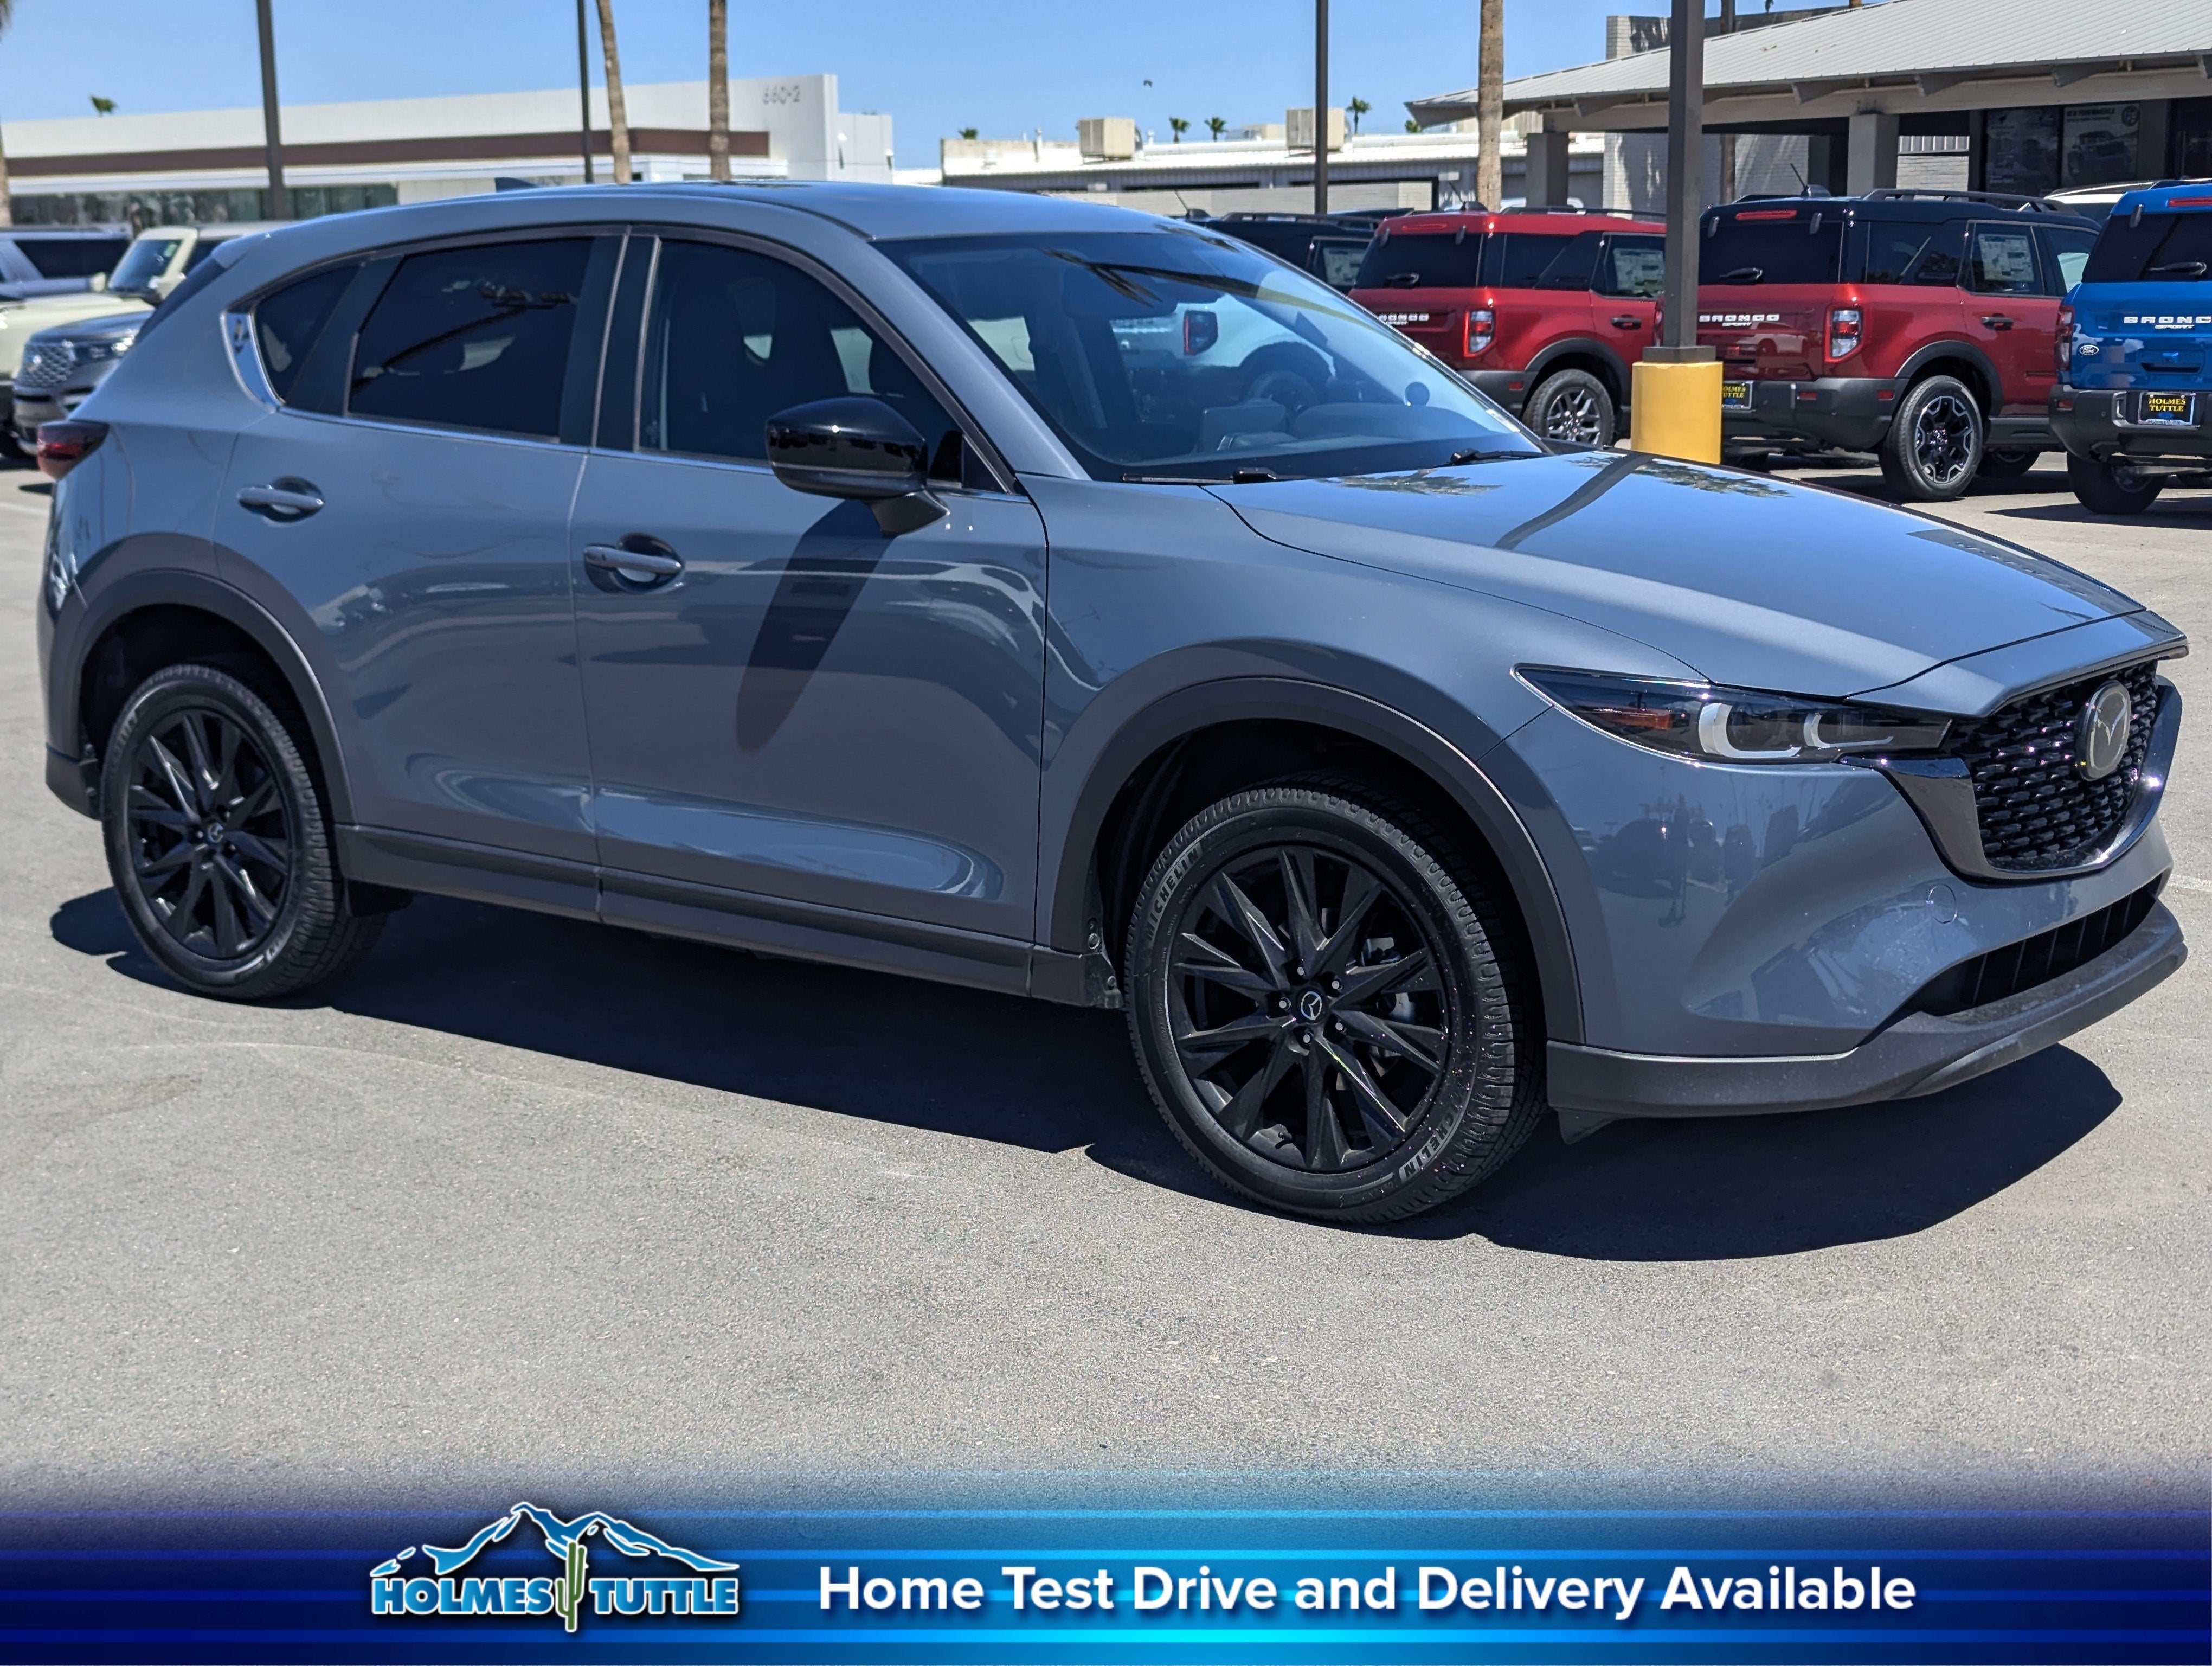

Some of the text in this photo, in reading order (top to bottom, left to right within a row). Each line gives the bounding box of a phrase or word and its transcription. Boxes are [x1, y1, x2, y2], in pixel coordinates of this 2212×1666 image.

[762, 84, 801, 105] 660-2
[1378, 313, 1430, 322] RONCO
[1146, 847, 1199, 942] MICHELIN
